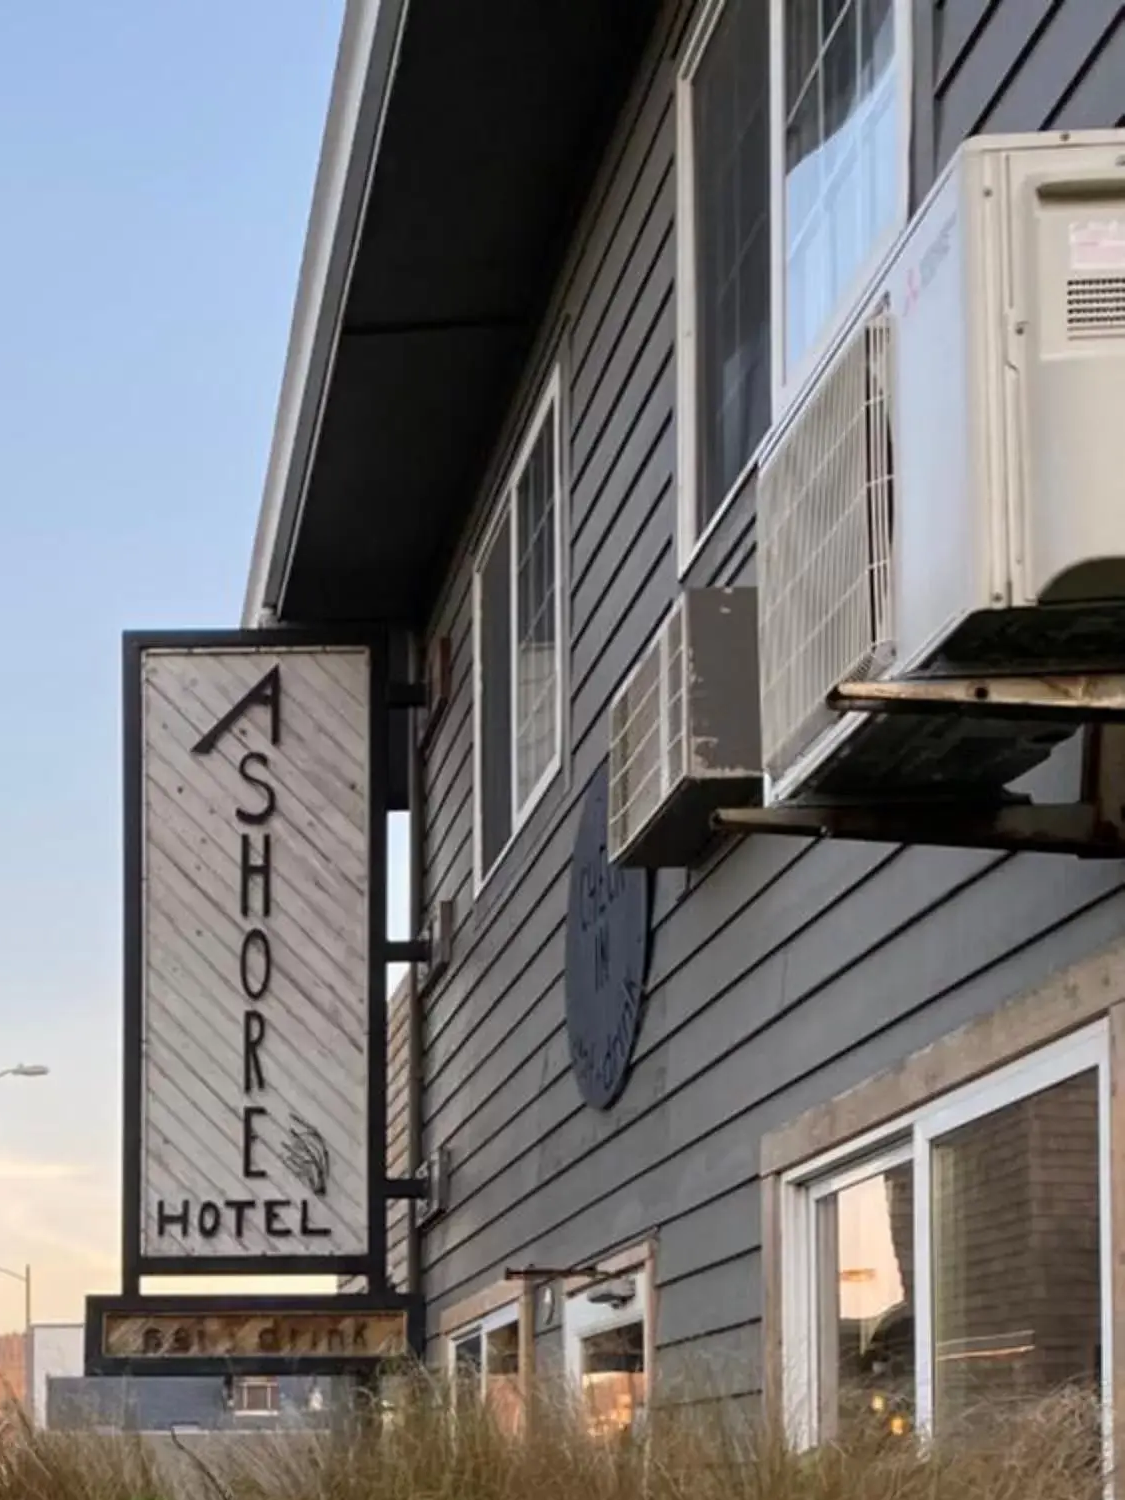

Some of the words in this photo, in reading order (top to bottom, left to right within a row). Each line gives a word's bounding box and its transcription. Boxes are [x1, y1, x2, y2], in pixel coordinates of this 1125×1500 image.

[192, 662, 280, 1181] ASHORE
[158, 1198, 332, 1239] HOTEL
[259, 1319, 368, 1353] drink
